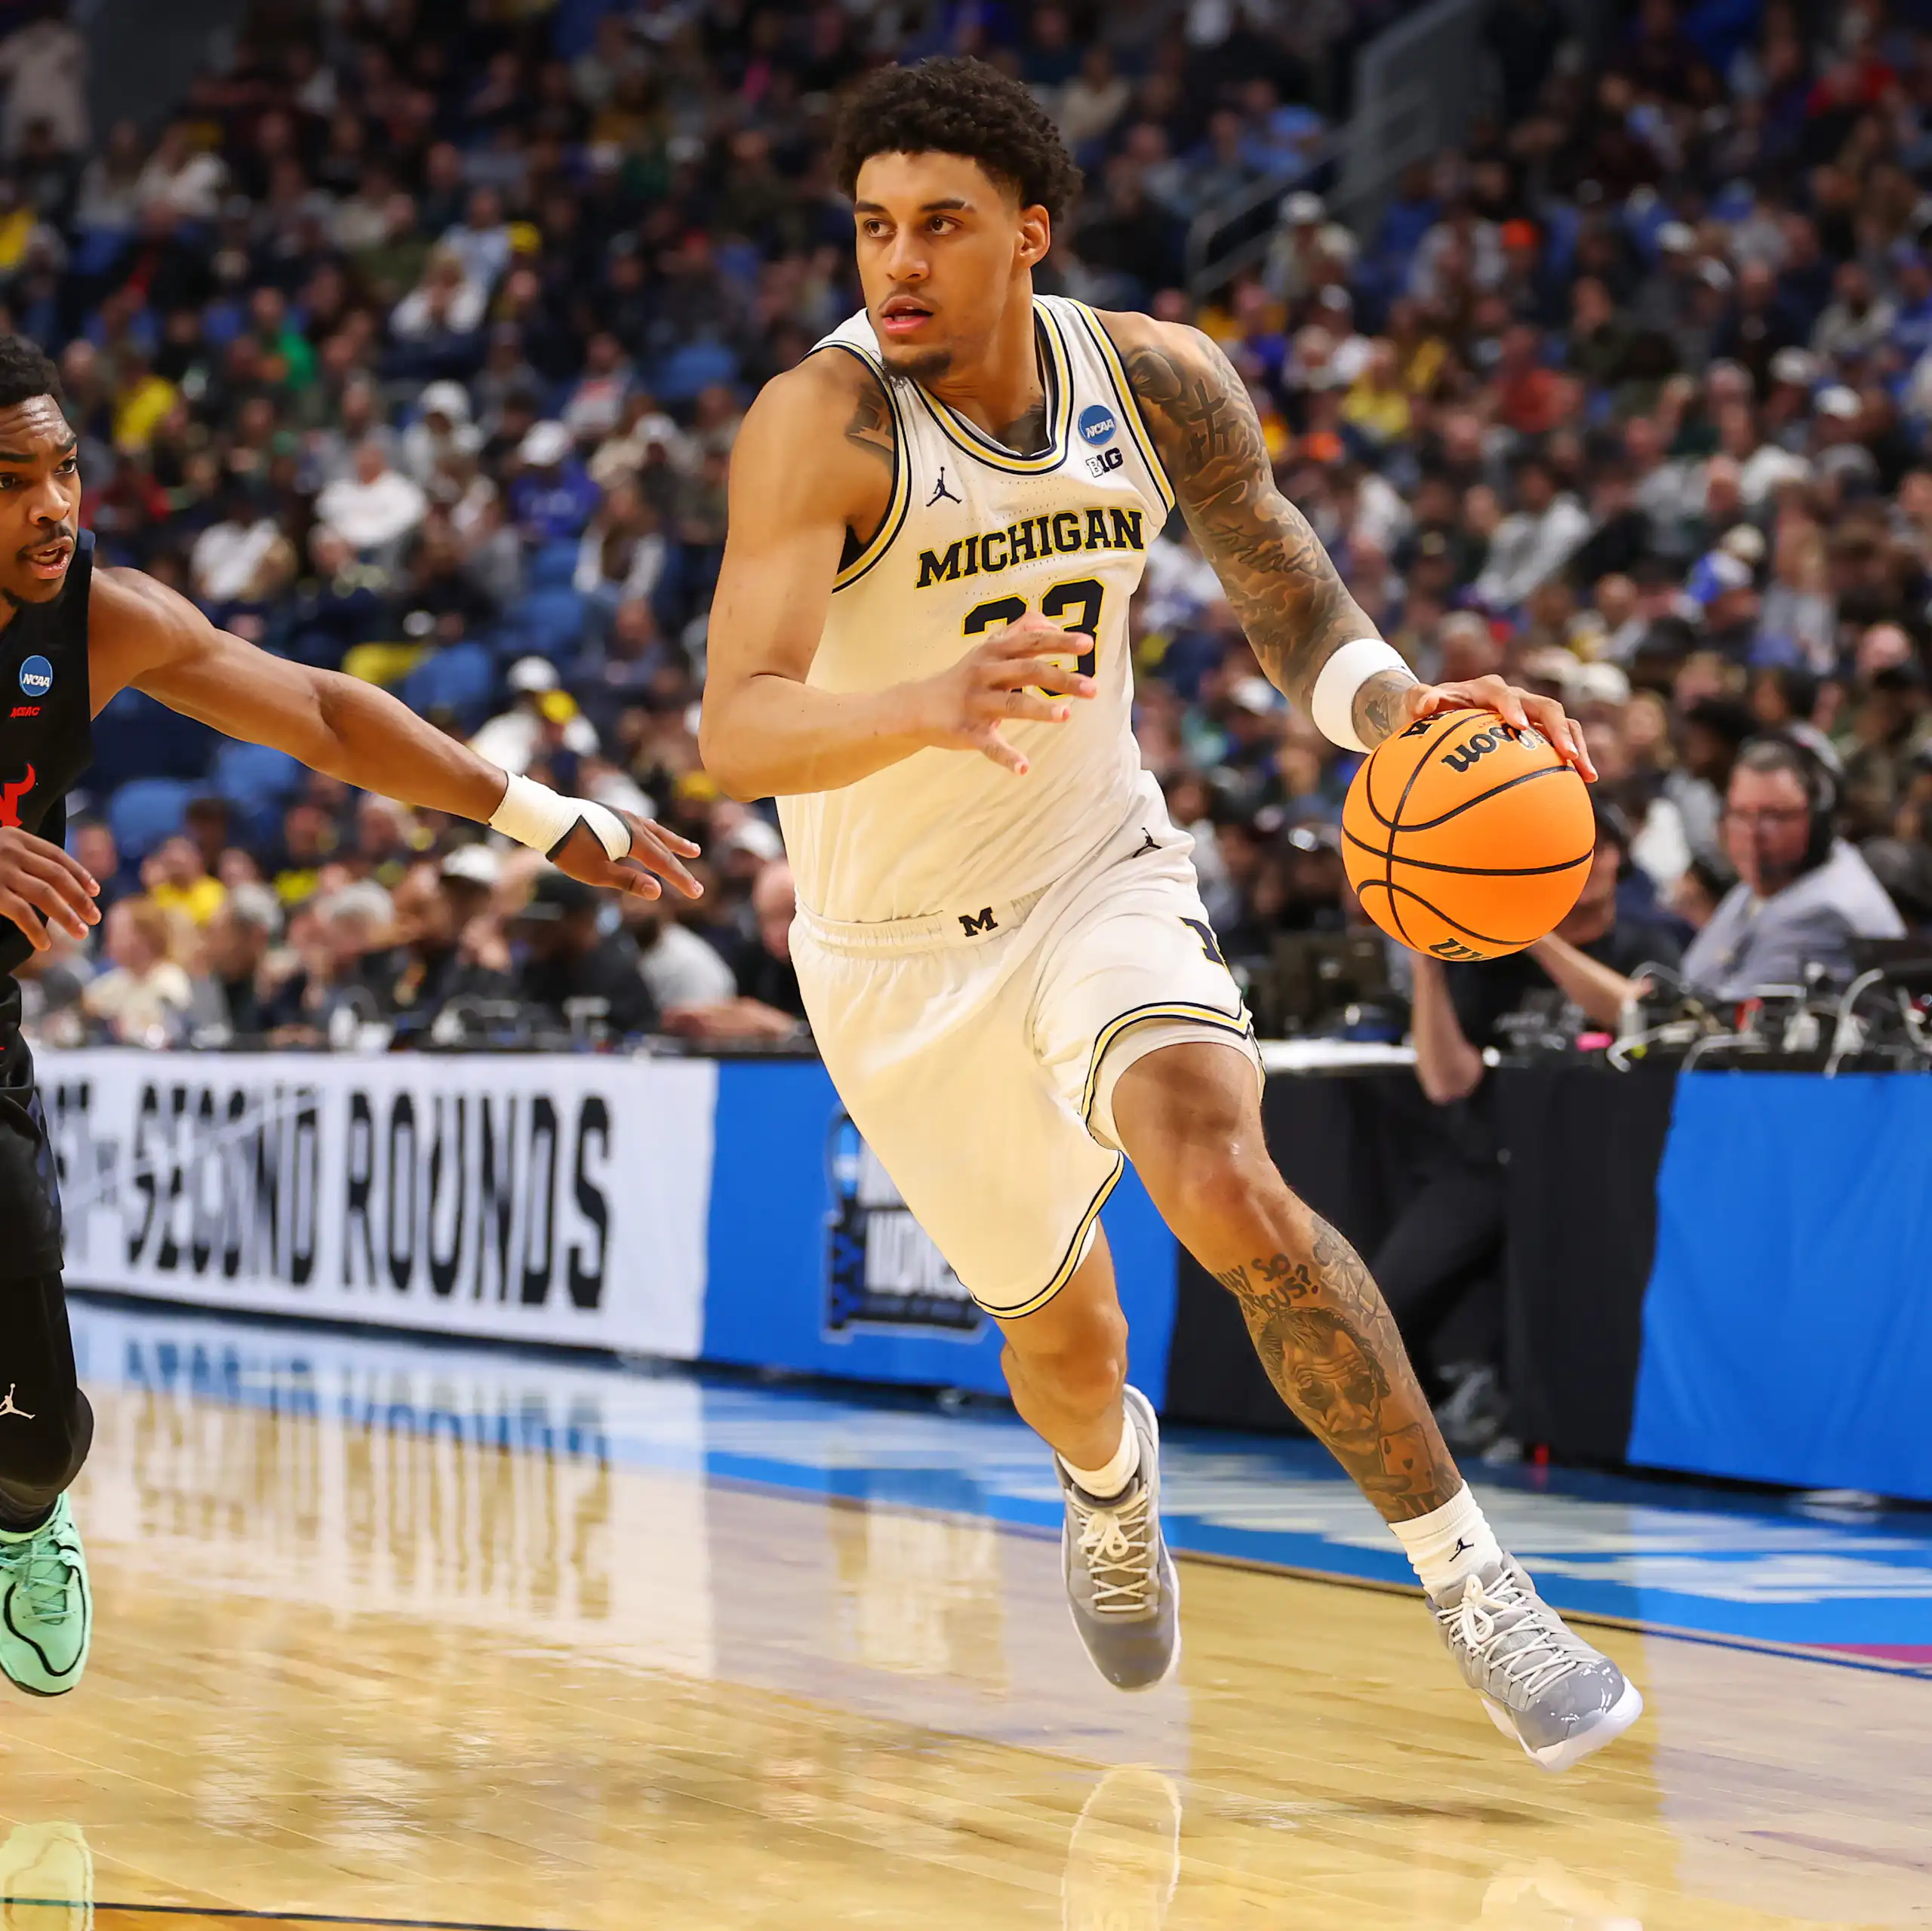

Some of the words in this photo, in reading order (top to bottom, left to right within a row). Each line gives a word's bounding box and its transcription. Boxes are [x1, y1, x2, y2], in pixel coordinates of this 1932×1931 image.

[1085, 418, 1115, 438] NCAA
[914, 506, 1146, 590] MICHIGAN
[23, 673, 51, 687] NCAA
[958, 906, 999, 937] M
[343, 1089, 613, 1310] ROUNDS
[1251, 1253, 1291, 1281] SO
